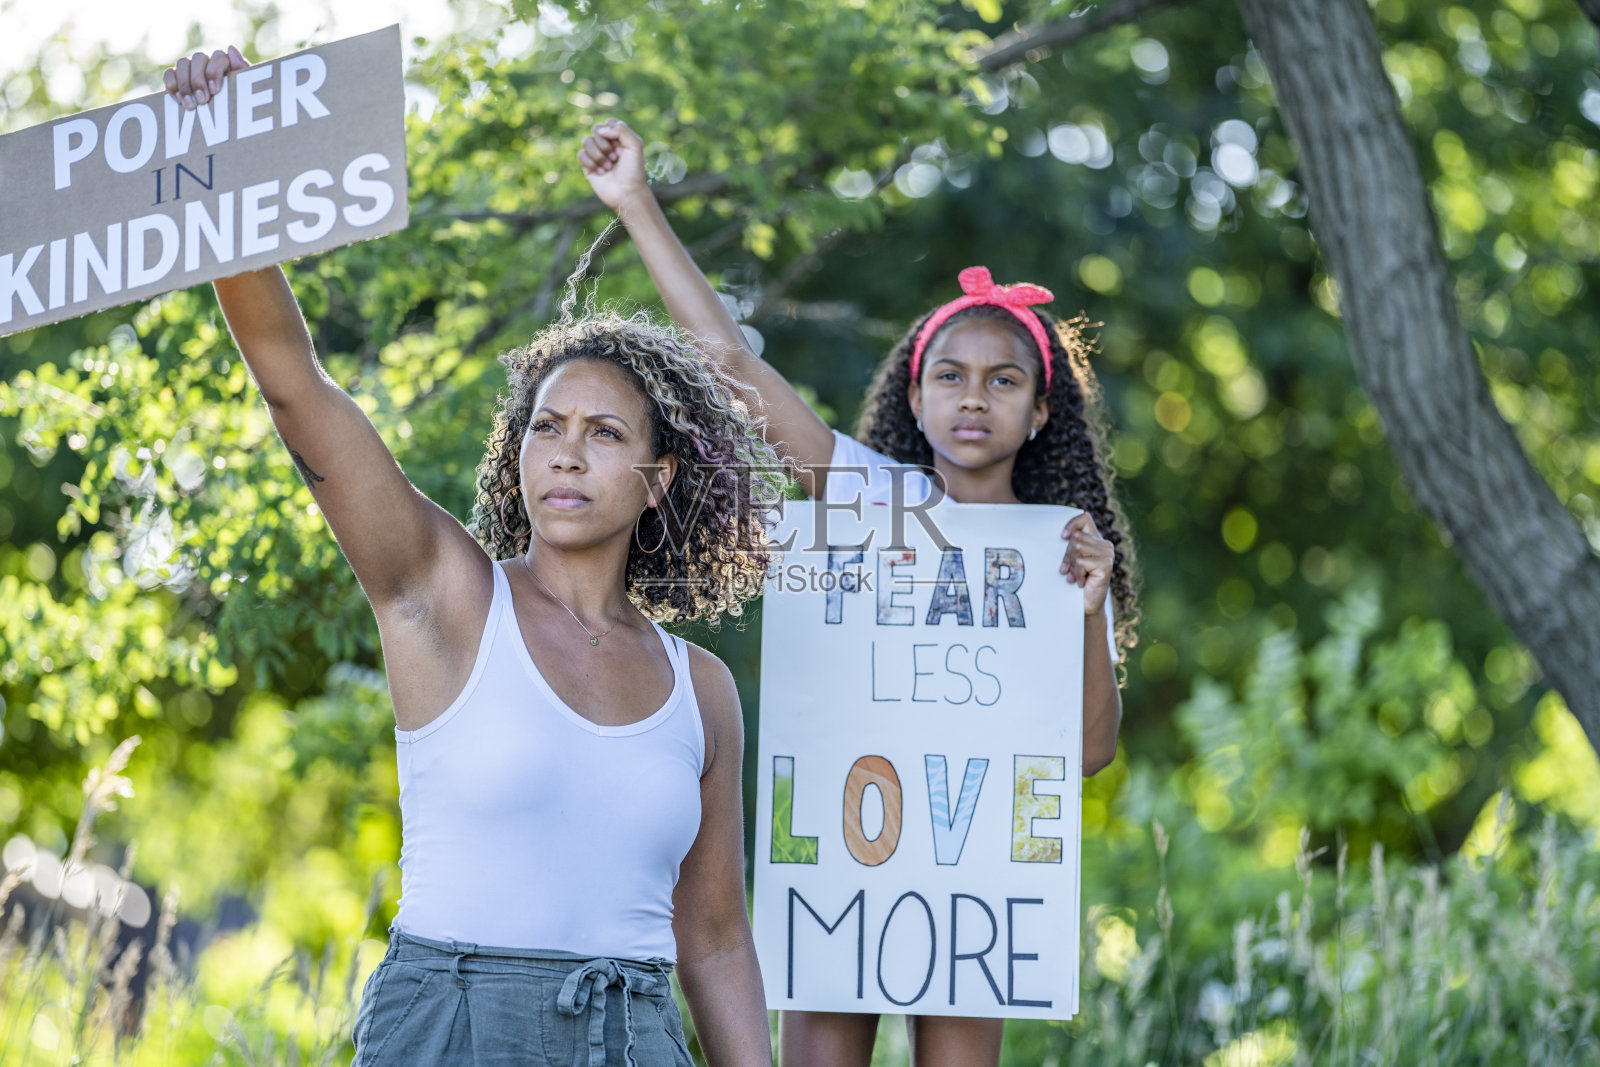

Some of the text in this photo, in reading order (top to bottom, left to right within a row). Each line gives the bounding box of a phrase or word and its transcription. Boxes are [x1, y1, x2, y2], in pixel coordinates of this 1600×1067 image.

[52, 53, 331, 191] POWER
[151, 153, 215, 206] IN
[0, 153, 395, 324] KINDNESS
[825, 545, 1027, 628] FEAR
[872, 641, 1002, 706] LESS
[770, 754, 1065, 867] LOVE
[787, 887, 1053, 1009] MORE
